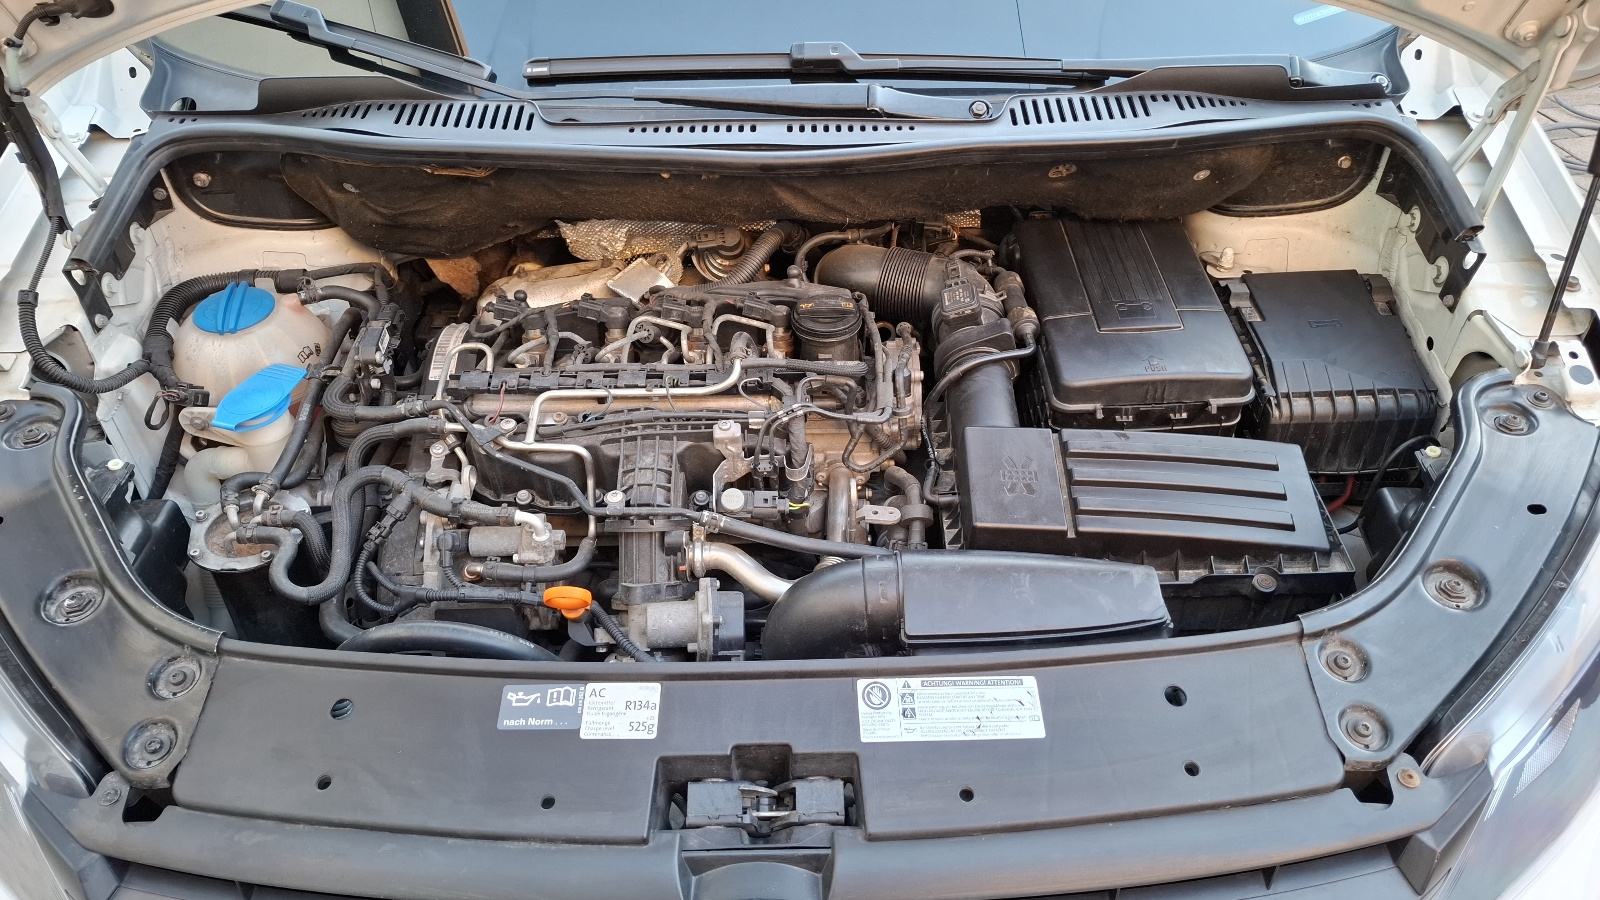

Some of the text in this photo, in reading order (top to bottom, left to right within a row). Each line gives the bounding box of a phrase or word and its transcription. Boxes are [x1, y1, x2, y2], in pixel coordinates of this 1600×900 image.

[956, 679, 986, 687] WARNING!
[589, 687, 606, 698] AC
[624, 700, 657, 711] R134a
[503, 718, 526, 726] nach
[628, 721, 655, 735] 525g
